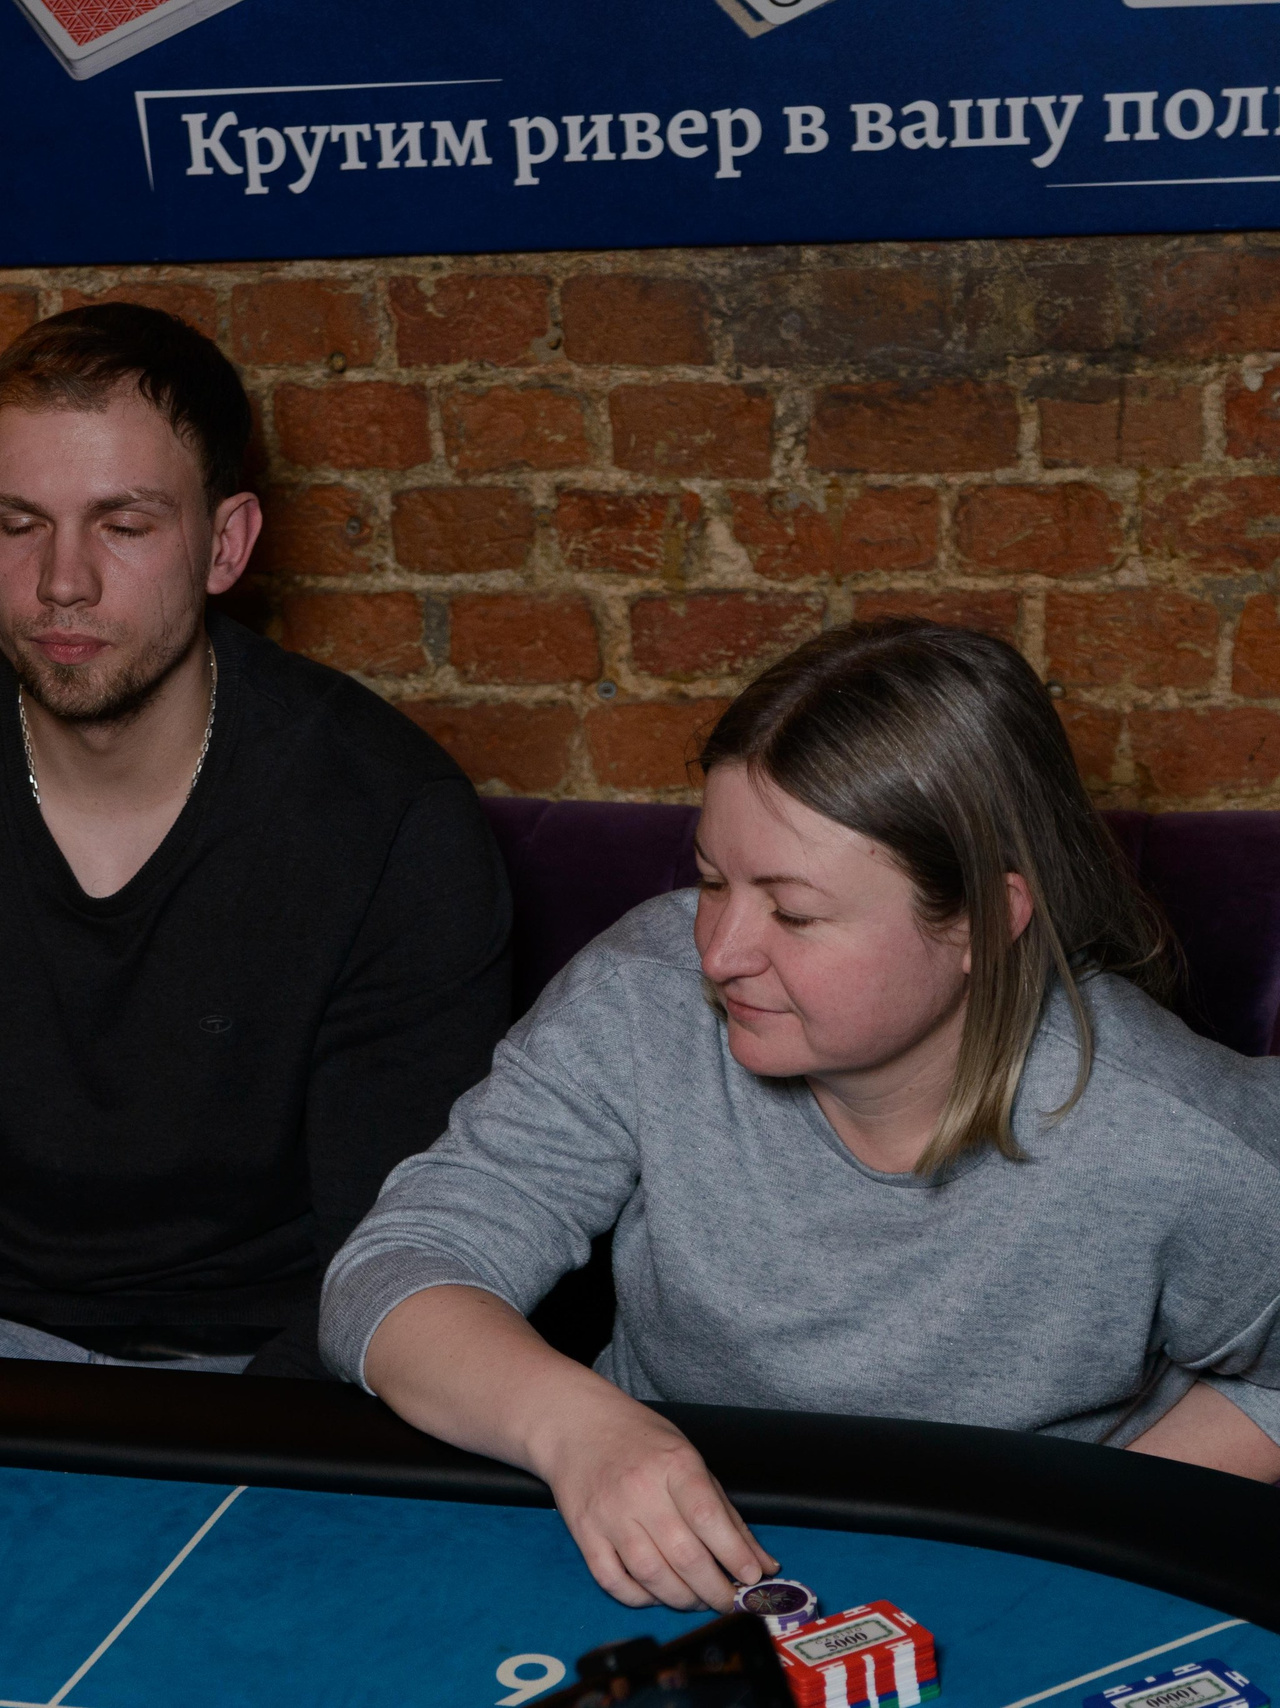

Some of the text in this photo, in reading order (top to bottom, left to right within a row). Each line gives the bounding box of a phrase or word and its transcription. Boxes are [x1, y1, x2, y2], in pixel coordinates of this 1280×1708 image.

[181, 86, 1280, 195] Крутим ривер в вашу пол
[824, 1632, 868, 1652] 5000
[1145, 1686, 1199, 1708] 10000
